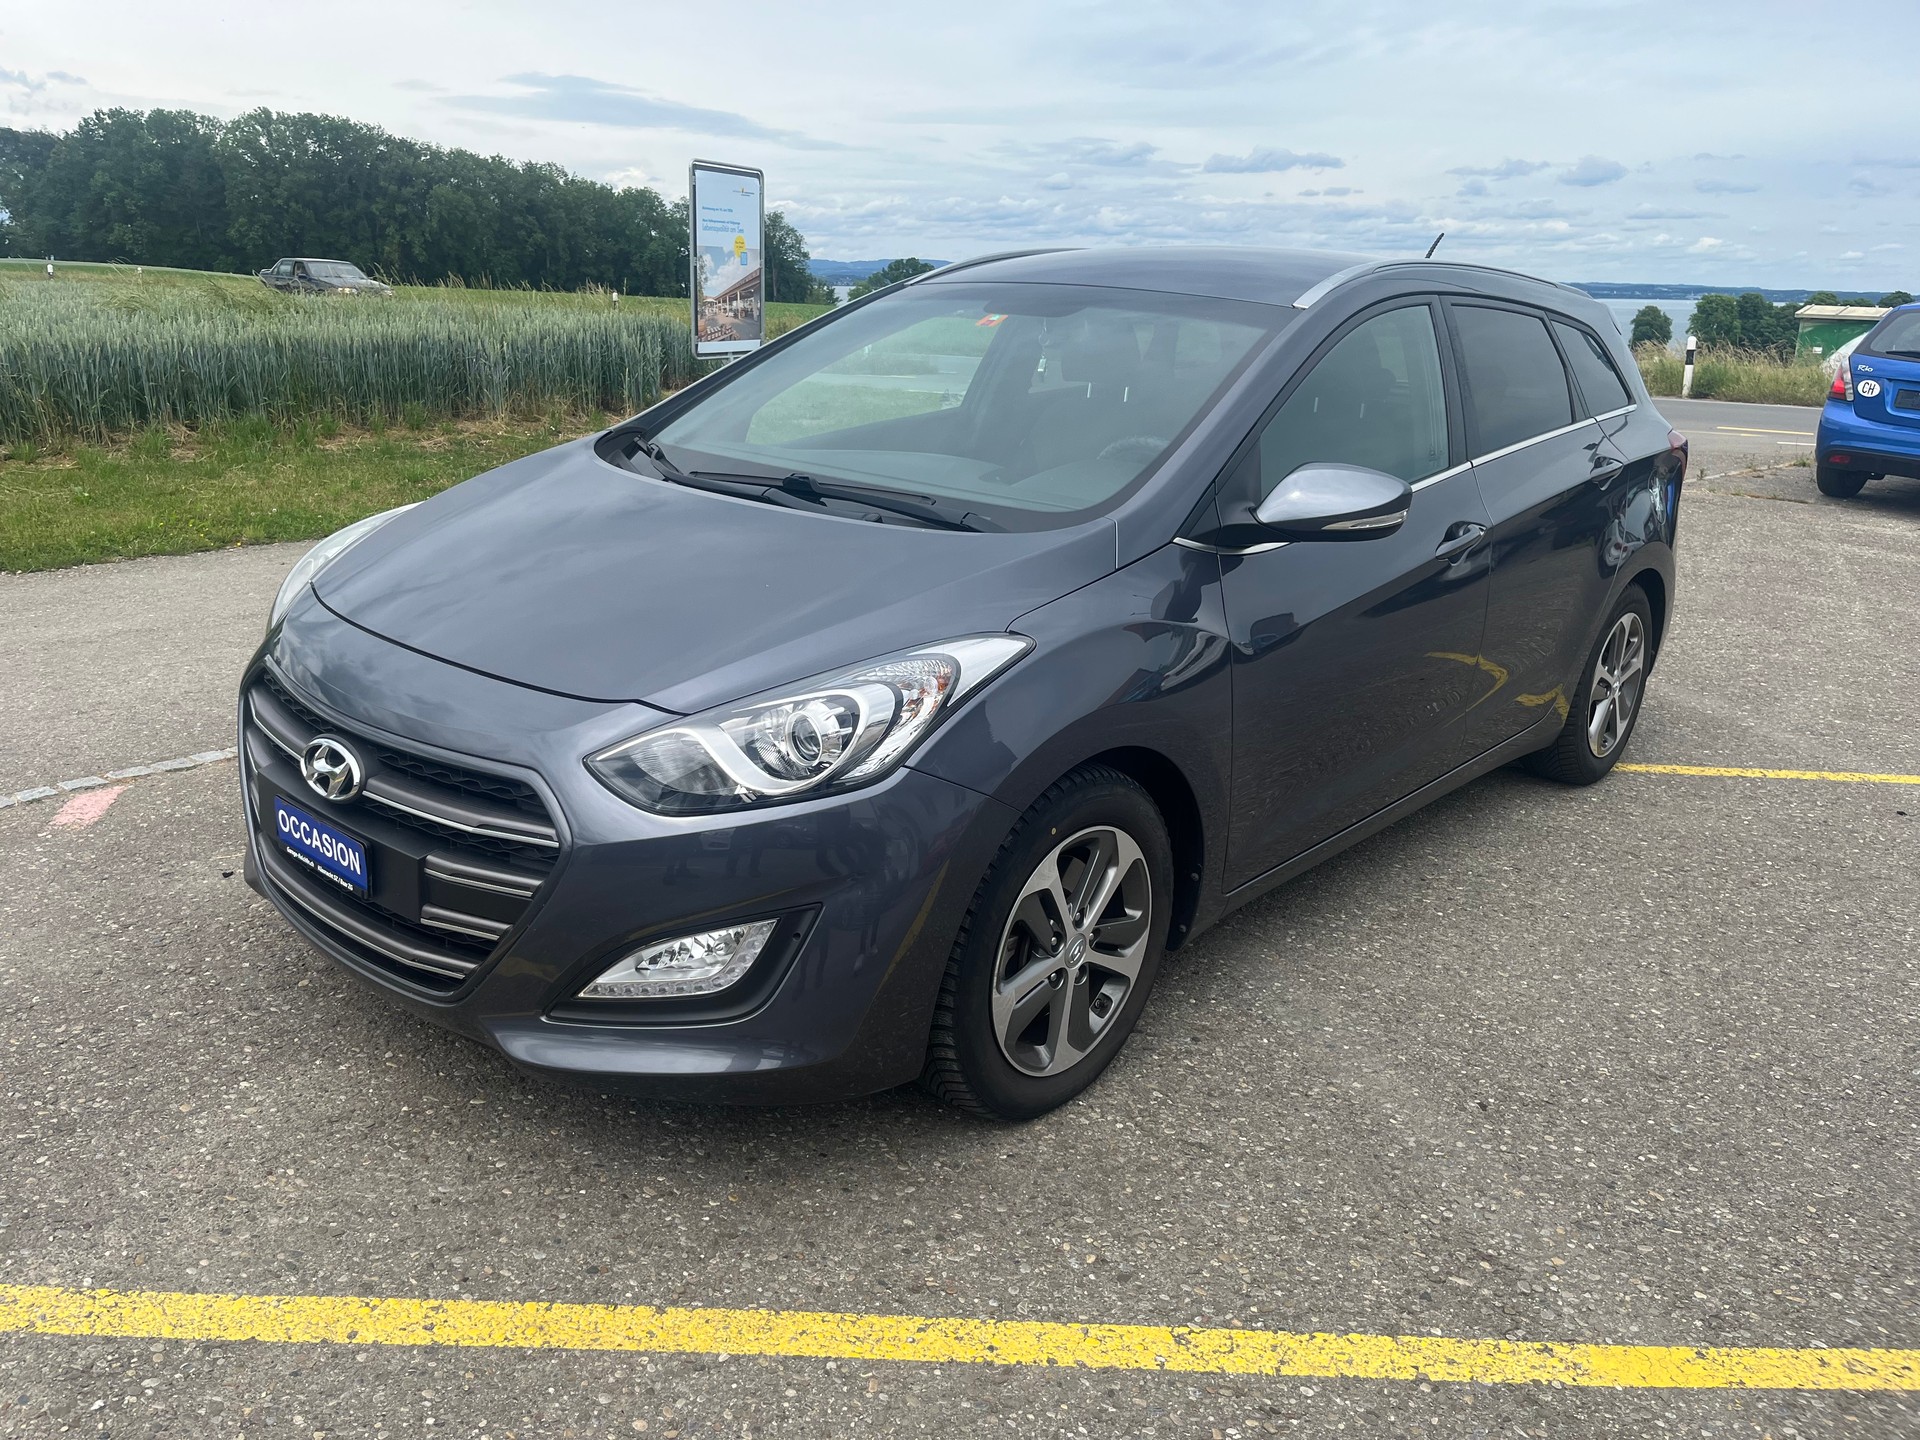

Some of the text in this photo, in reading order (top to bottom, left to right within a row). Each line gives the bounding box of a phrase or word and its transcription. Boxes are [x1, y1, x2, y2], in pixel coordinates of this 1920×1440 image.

[1857, 364, 1874, 372] Rio
[1862, 381, 1876, 395] CH
[278, 809, 361, 876] OCCASION
